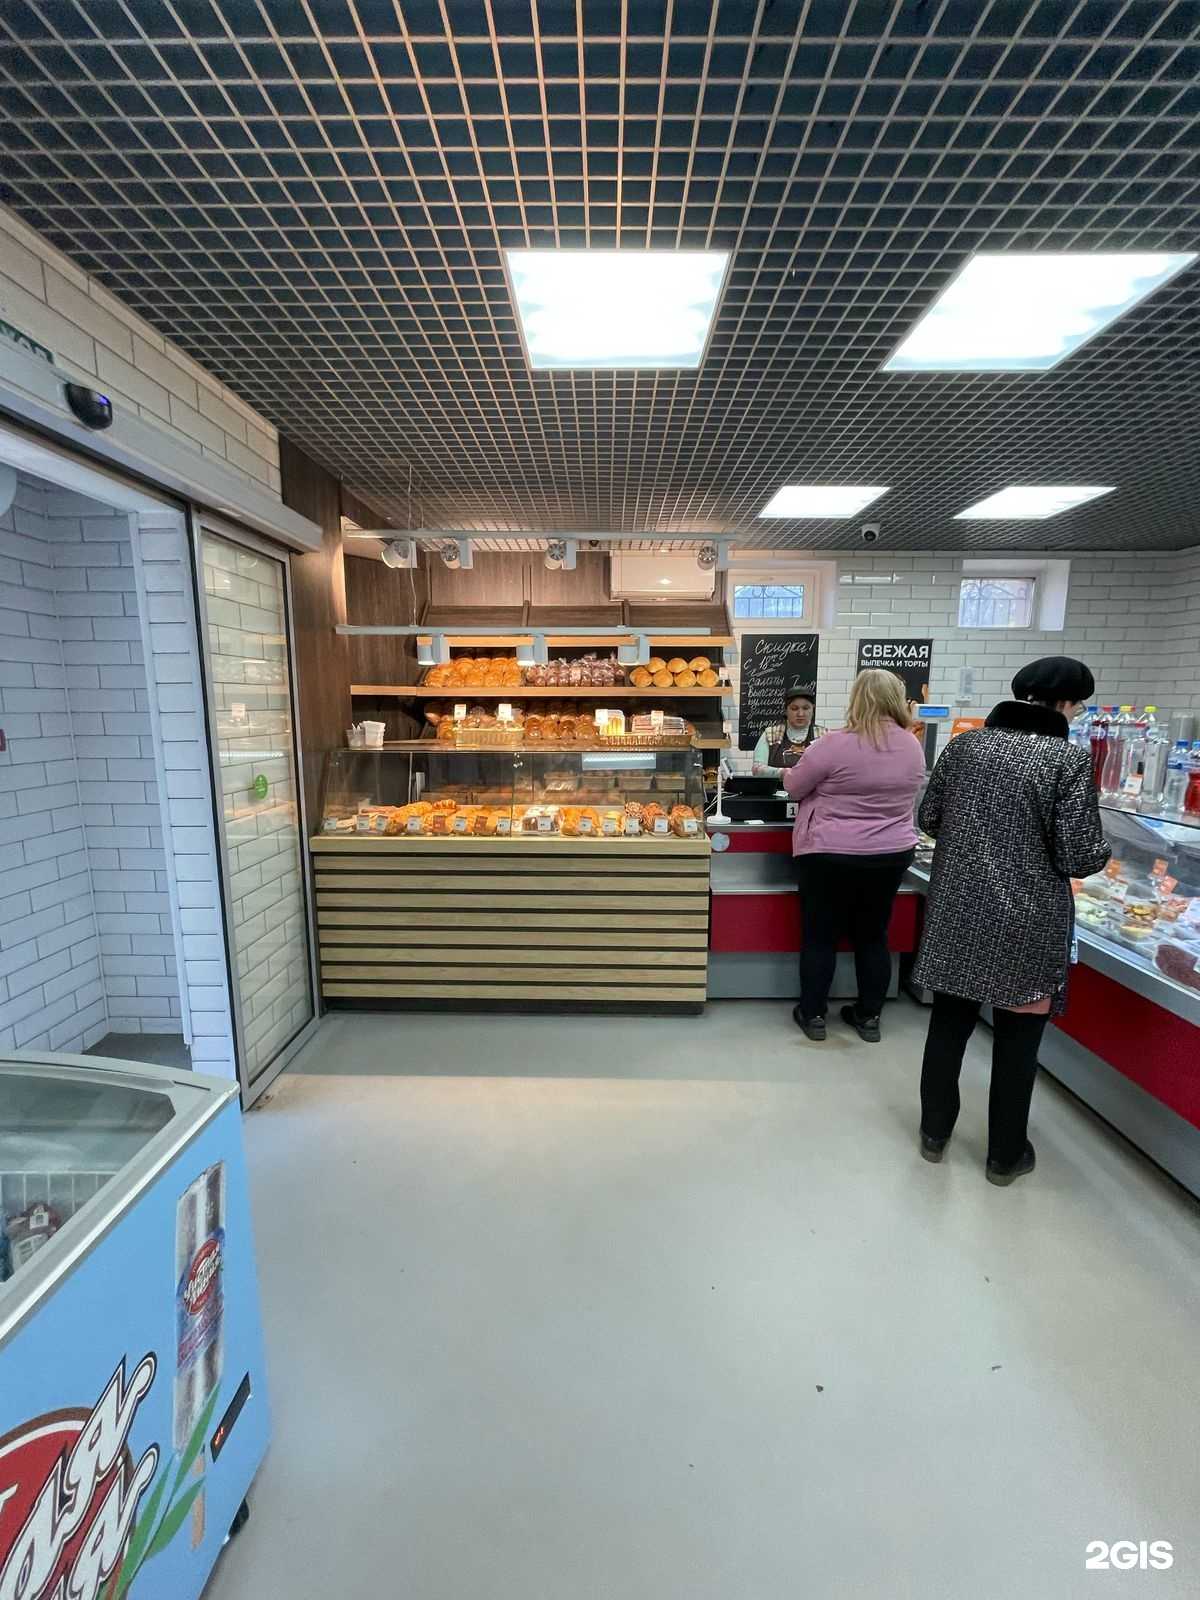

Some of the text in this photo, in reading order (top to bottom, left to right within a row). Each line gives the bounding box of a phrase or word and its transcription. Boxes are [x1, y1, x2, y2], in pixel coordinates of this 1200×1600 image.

[862, 644, 929, 658] СВЕЖАЯ
[861, 659, 895, 667] ВЫПЕЧКА
[904, 660, 929, 668] ТОРТЫ
